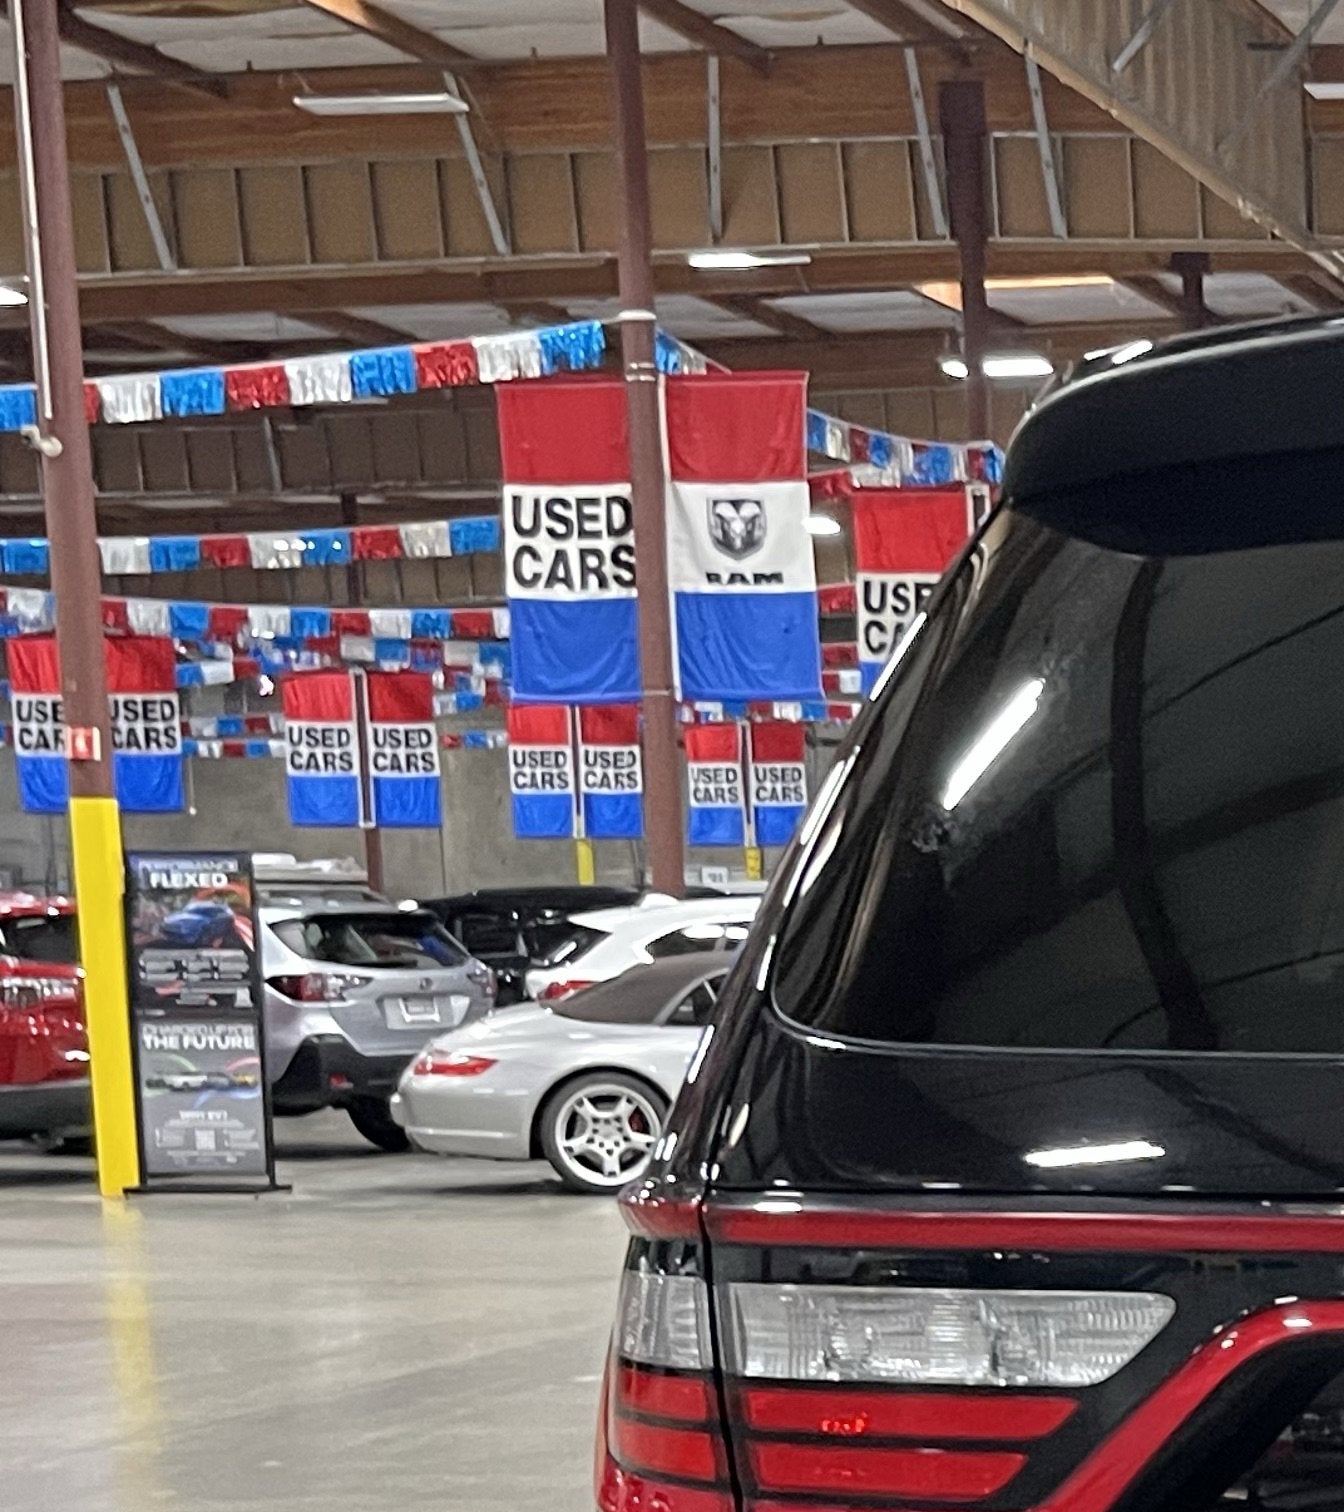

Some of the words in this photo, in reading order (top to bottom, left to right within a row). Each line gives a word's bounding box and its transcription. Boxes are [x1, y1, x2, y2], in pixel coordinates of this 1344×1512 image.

[512, 496, 633, 539] USED
[512, 544, 636, 590] CARS
[706, 572, 783, 584] RAM
[16, 700, 65, 723] USE
[288, 726, 351, 749] USED
[373, 728, 432, 749] USED
[290, 751, 353, 772] CARS
[373, 752, 435, 773] CARS
[513, 750, 567, 769] USED
[584, 750, 637, 769] USED
[514, 771, 569, 789] CARS
[585, 771, 638, 789] CARS
[691, 767, 738, 784] USED
[755, 767, 802, 783] USED
[693, 787, 739, 803] CARS
[755, 786, 803, 802] CARS
